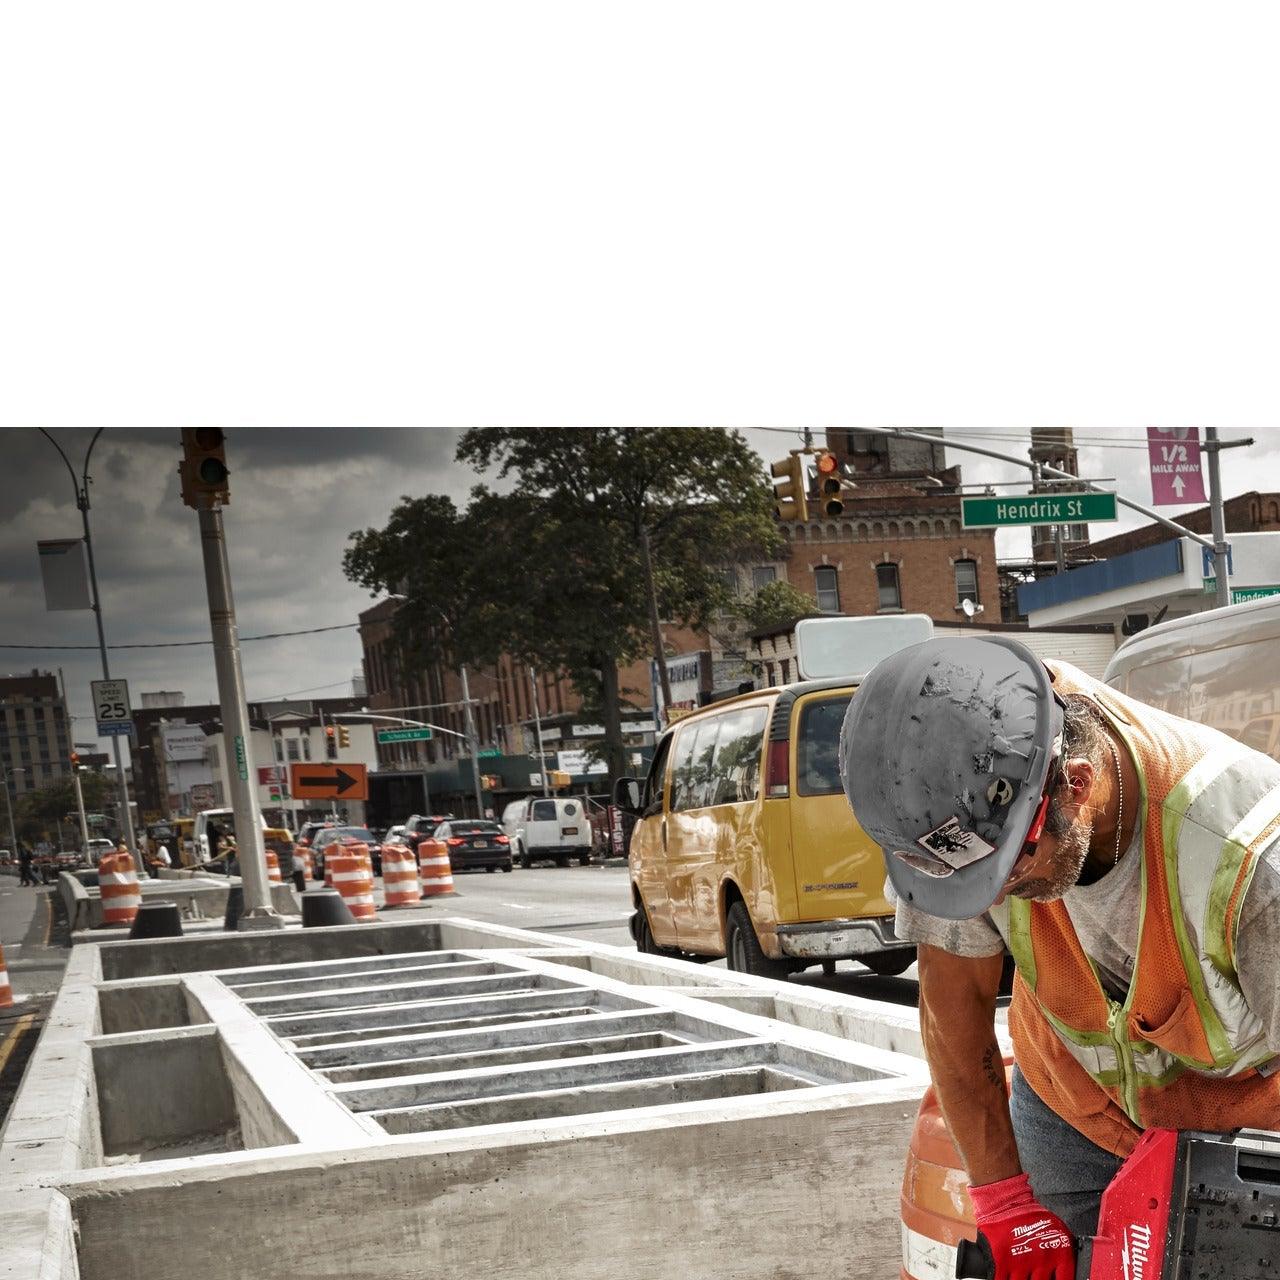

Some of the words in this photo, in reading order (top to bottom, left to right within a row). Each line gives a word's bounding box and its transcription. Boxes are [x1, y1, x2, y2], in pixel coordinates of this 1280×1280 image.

[1161, 445, 1188, 463] 1/2
[1152, 464, 1174, 473] MILE
[1175, 464, 1200, 473] AWAY
[997, 501, 1061, 520] Hendrix
[1067, 500, 1083, 517] St
[99, 703, 127, 719] 25
[1011, 1219, 1052, 1237] Milwaukee
